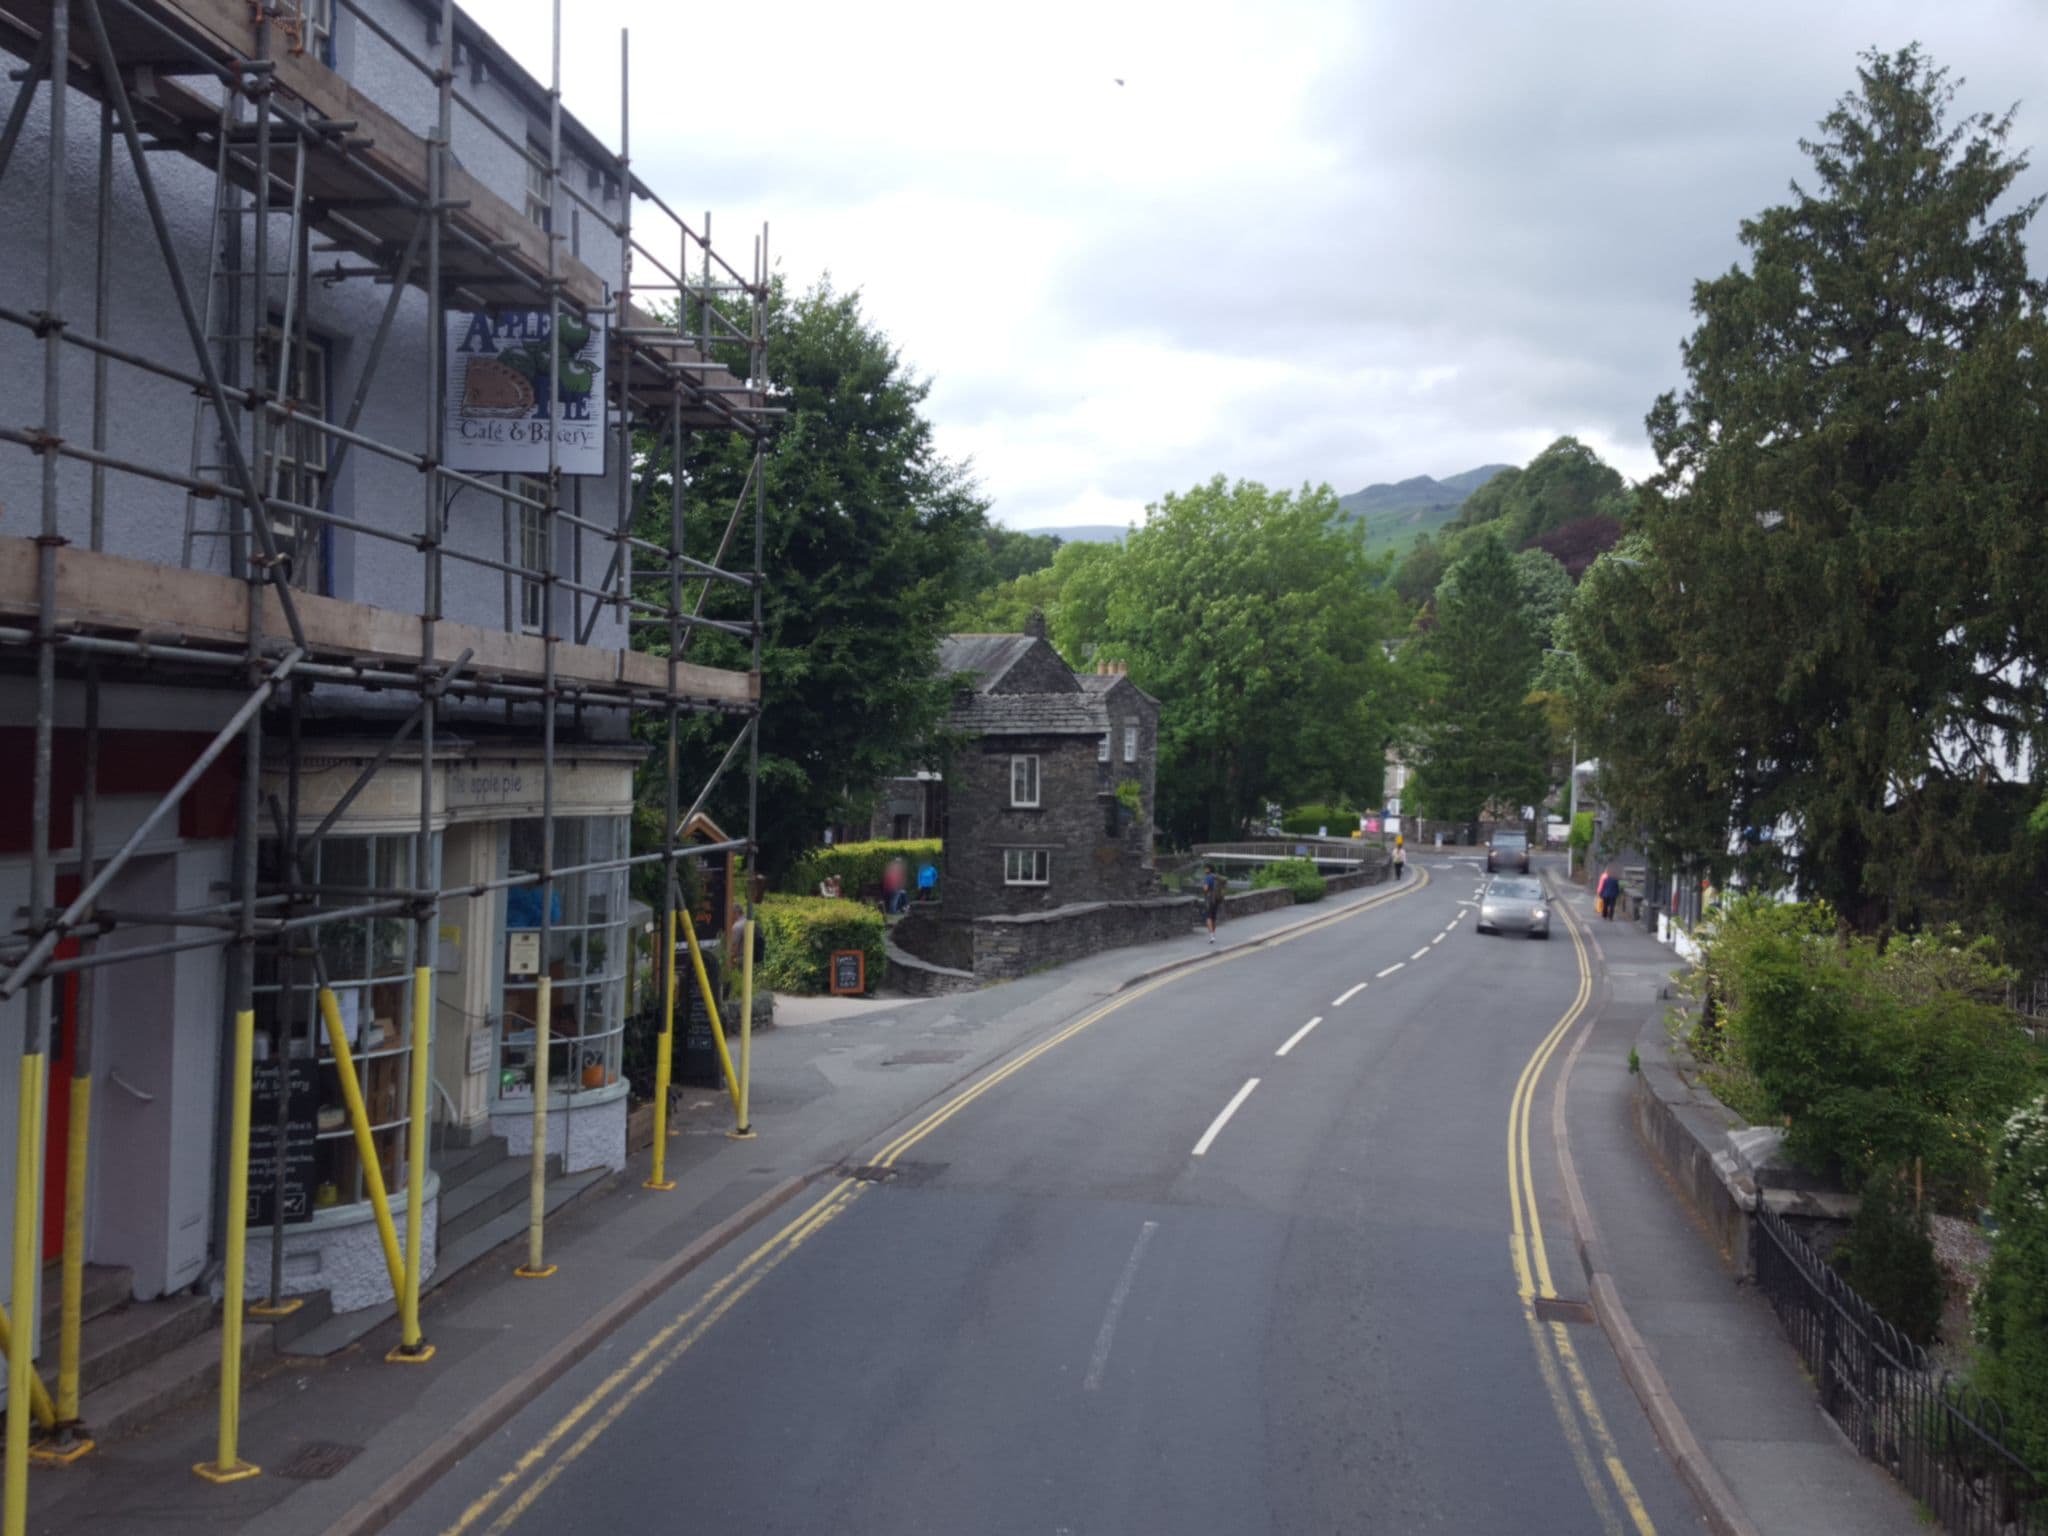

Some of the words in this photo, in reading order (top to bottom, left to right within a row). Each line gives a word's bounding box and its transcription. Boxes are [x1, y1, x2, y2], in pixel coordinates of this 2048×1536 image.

[461, 419, 504, 442] Café
[510, 422, 525, 442] &
[470, 775, 499, 802] apple
[502, 775, 522, 801] pie
